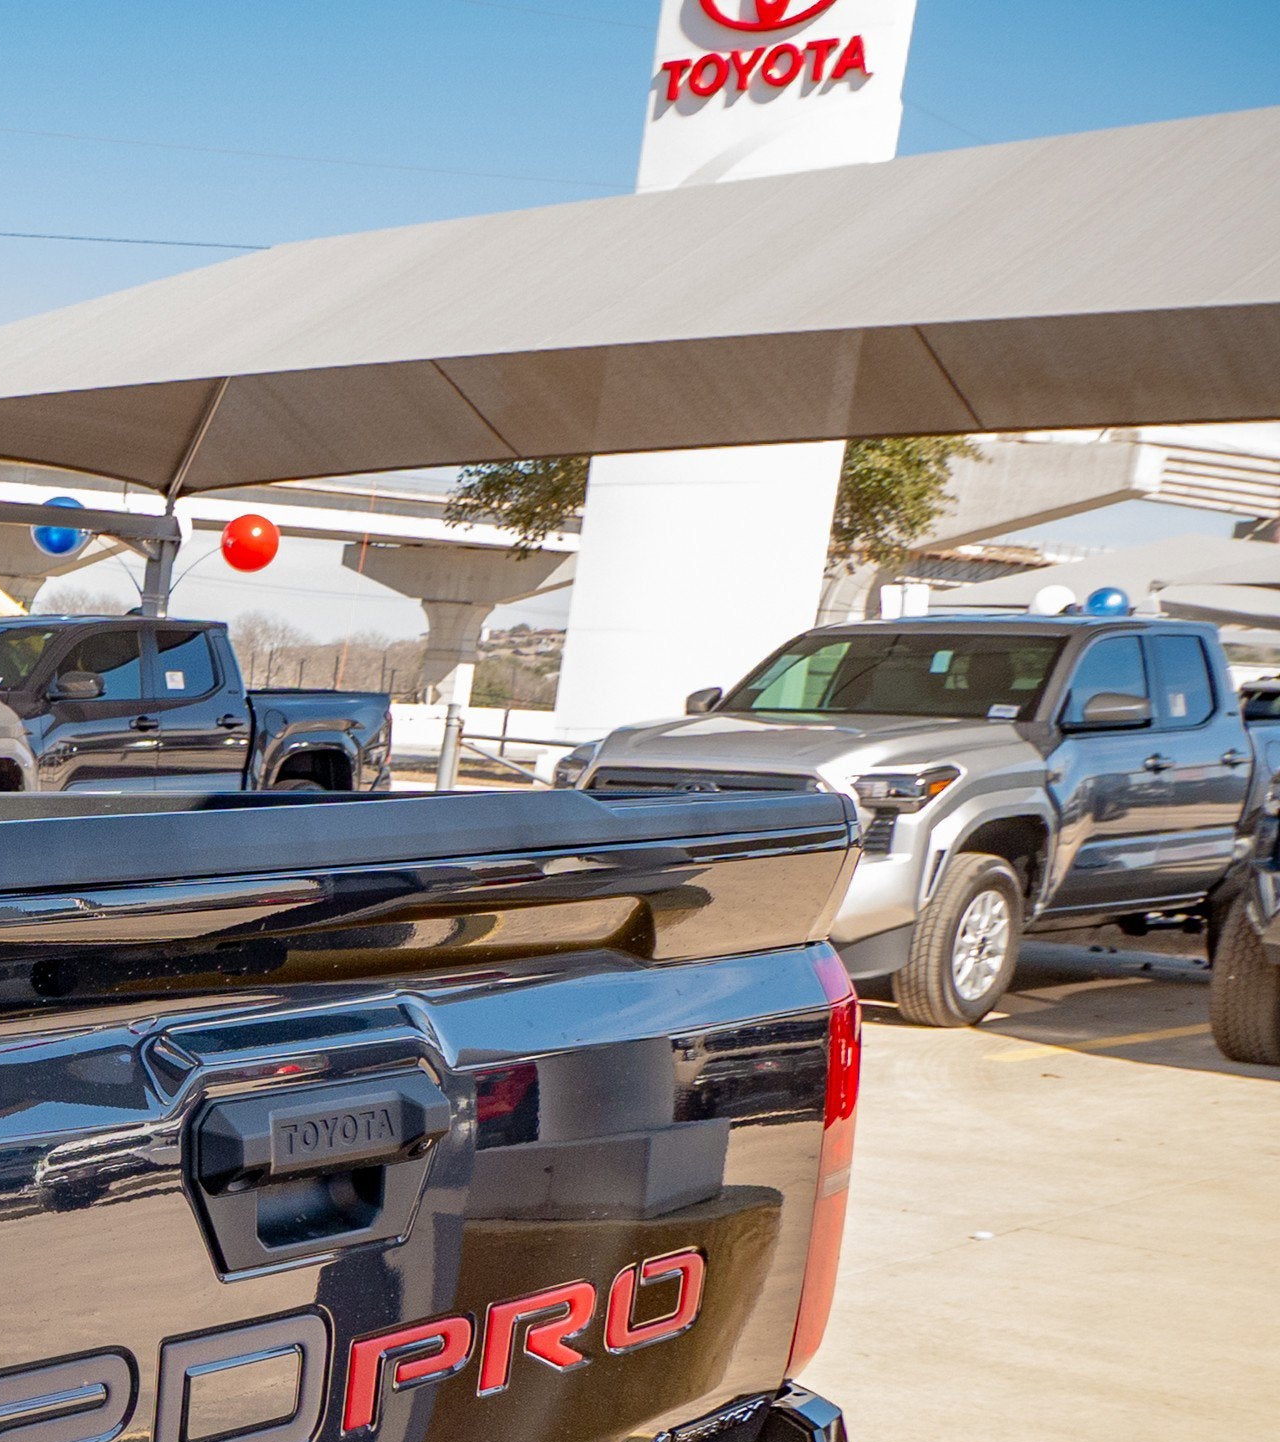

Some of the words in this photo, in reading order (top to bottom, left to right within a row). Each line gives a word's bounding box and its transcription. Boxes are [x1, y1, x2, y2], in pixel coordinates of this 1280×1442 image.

[662, 34, 873, 102] TOYOTA
[280, 1108, 395, 1155] TOYOTA
[341, 1247, 706, 1435] PRO
